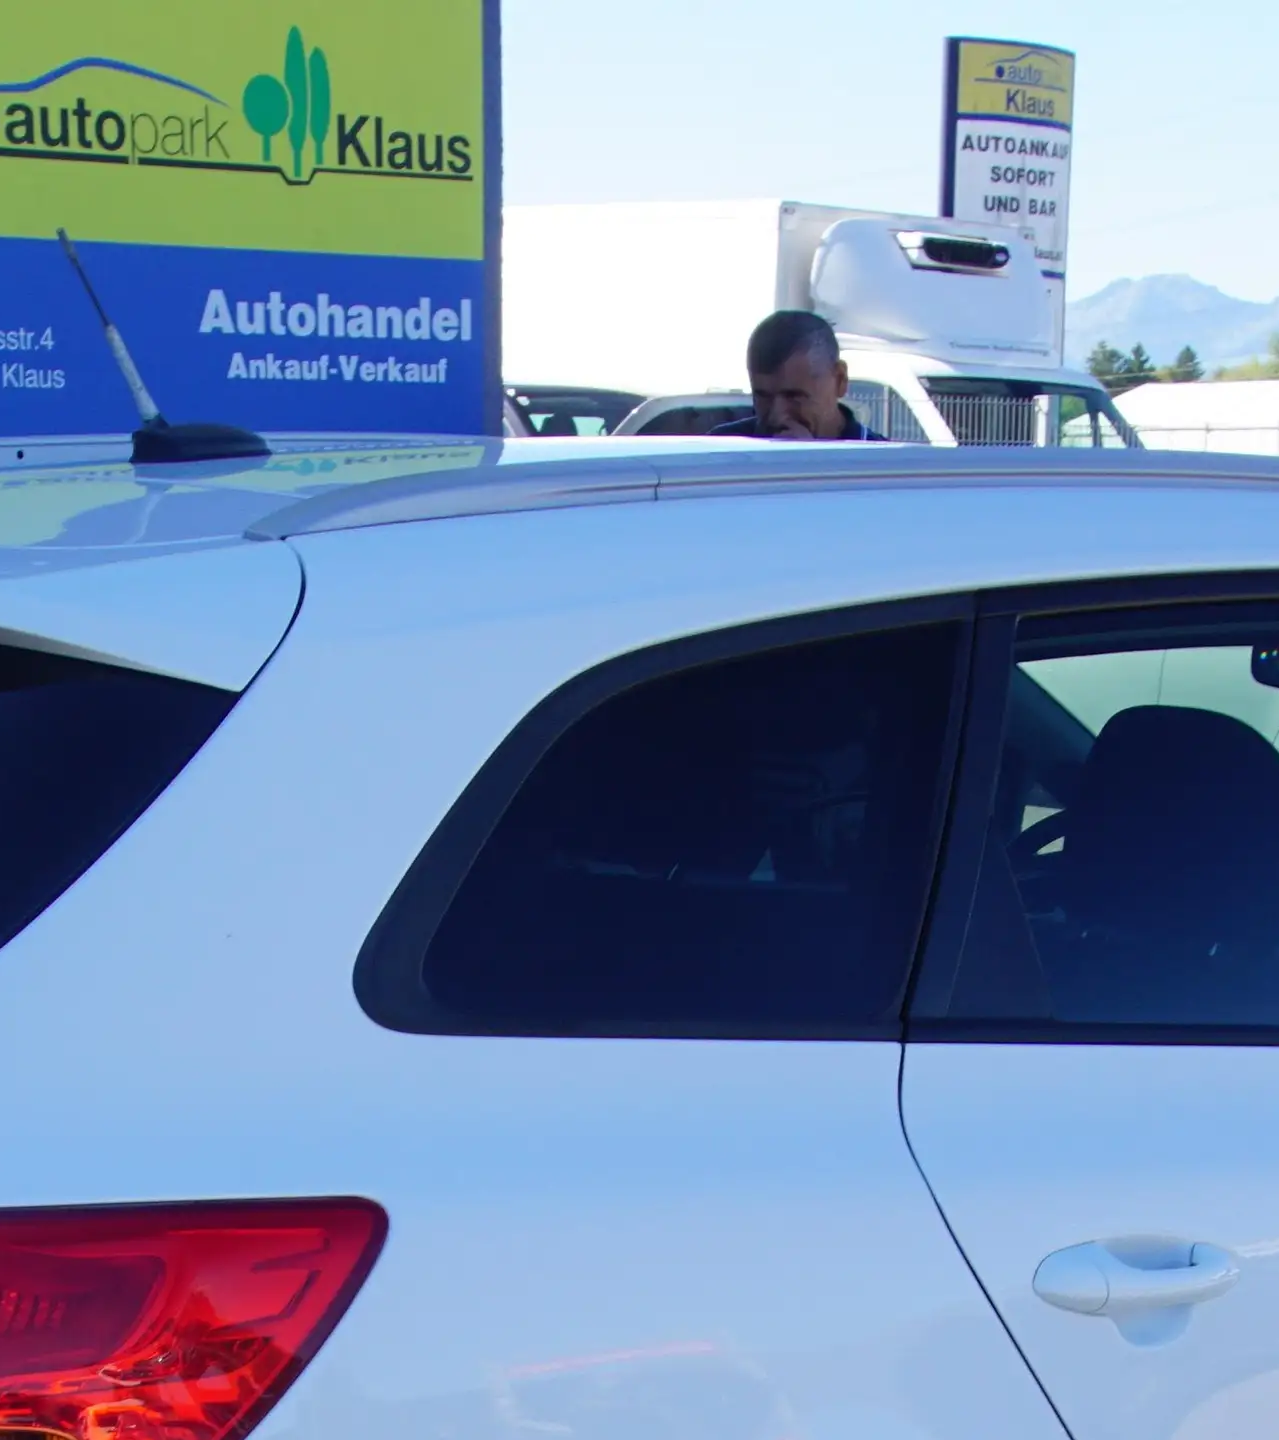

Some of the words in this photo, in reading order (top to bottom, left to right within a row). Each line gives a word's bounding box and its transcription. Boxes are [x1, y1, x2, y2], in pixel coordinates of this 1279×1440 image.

[1005, 87, 1056, 117] Klaus
[336, 112, 473, 175] Klaus
[989, 165, 1055, 187] SOFORT
[983, 194, 1020, 215] UND
[1028, 197, 1057, 217] BAR
[199, 287, 473, 342] Autohandel
[2, 363, 66, 390] Klaus
[227, 351, 448, 385] Ankauf-Verkauf
